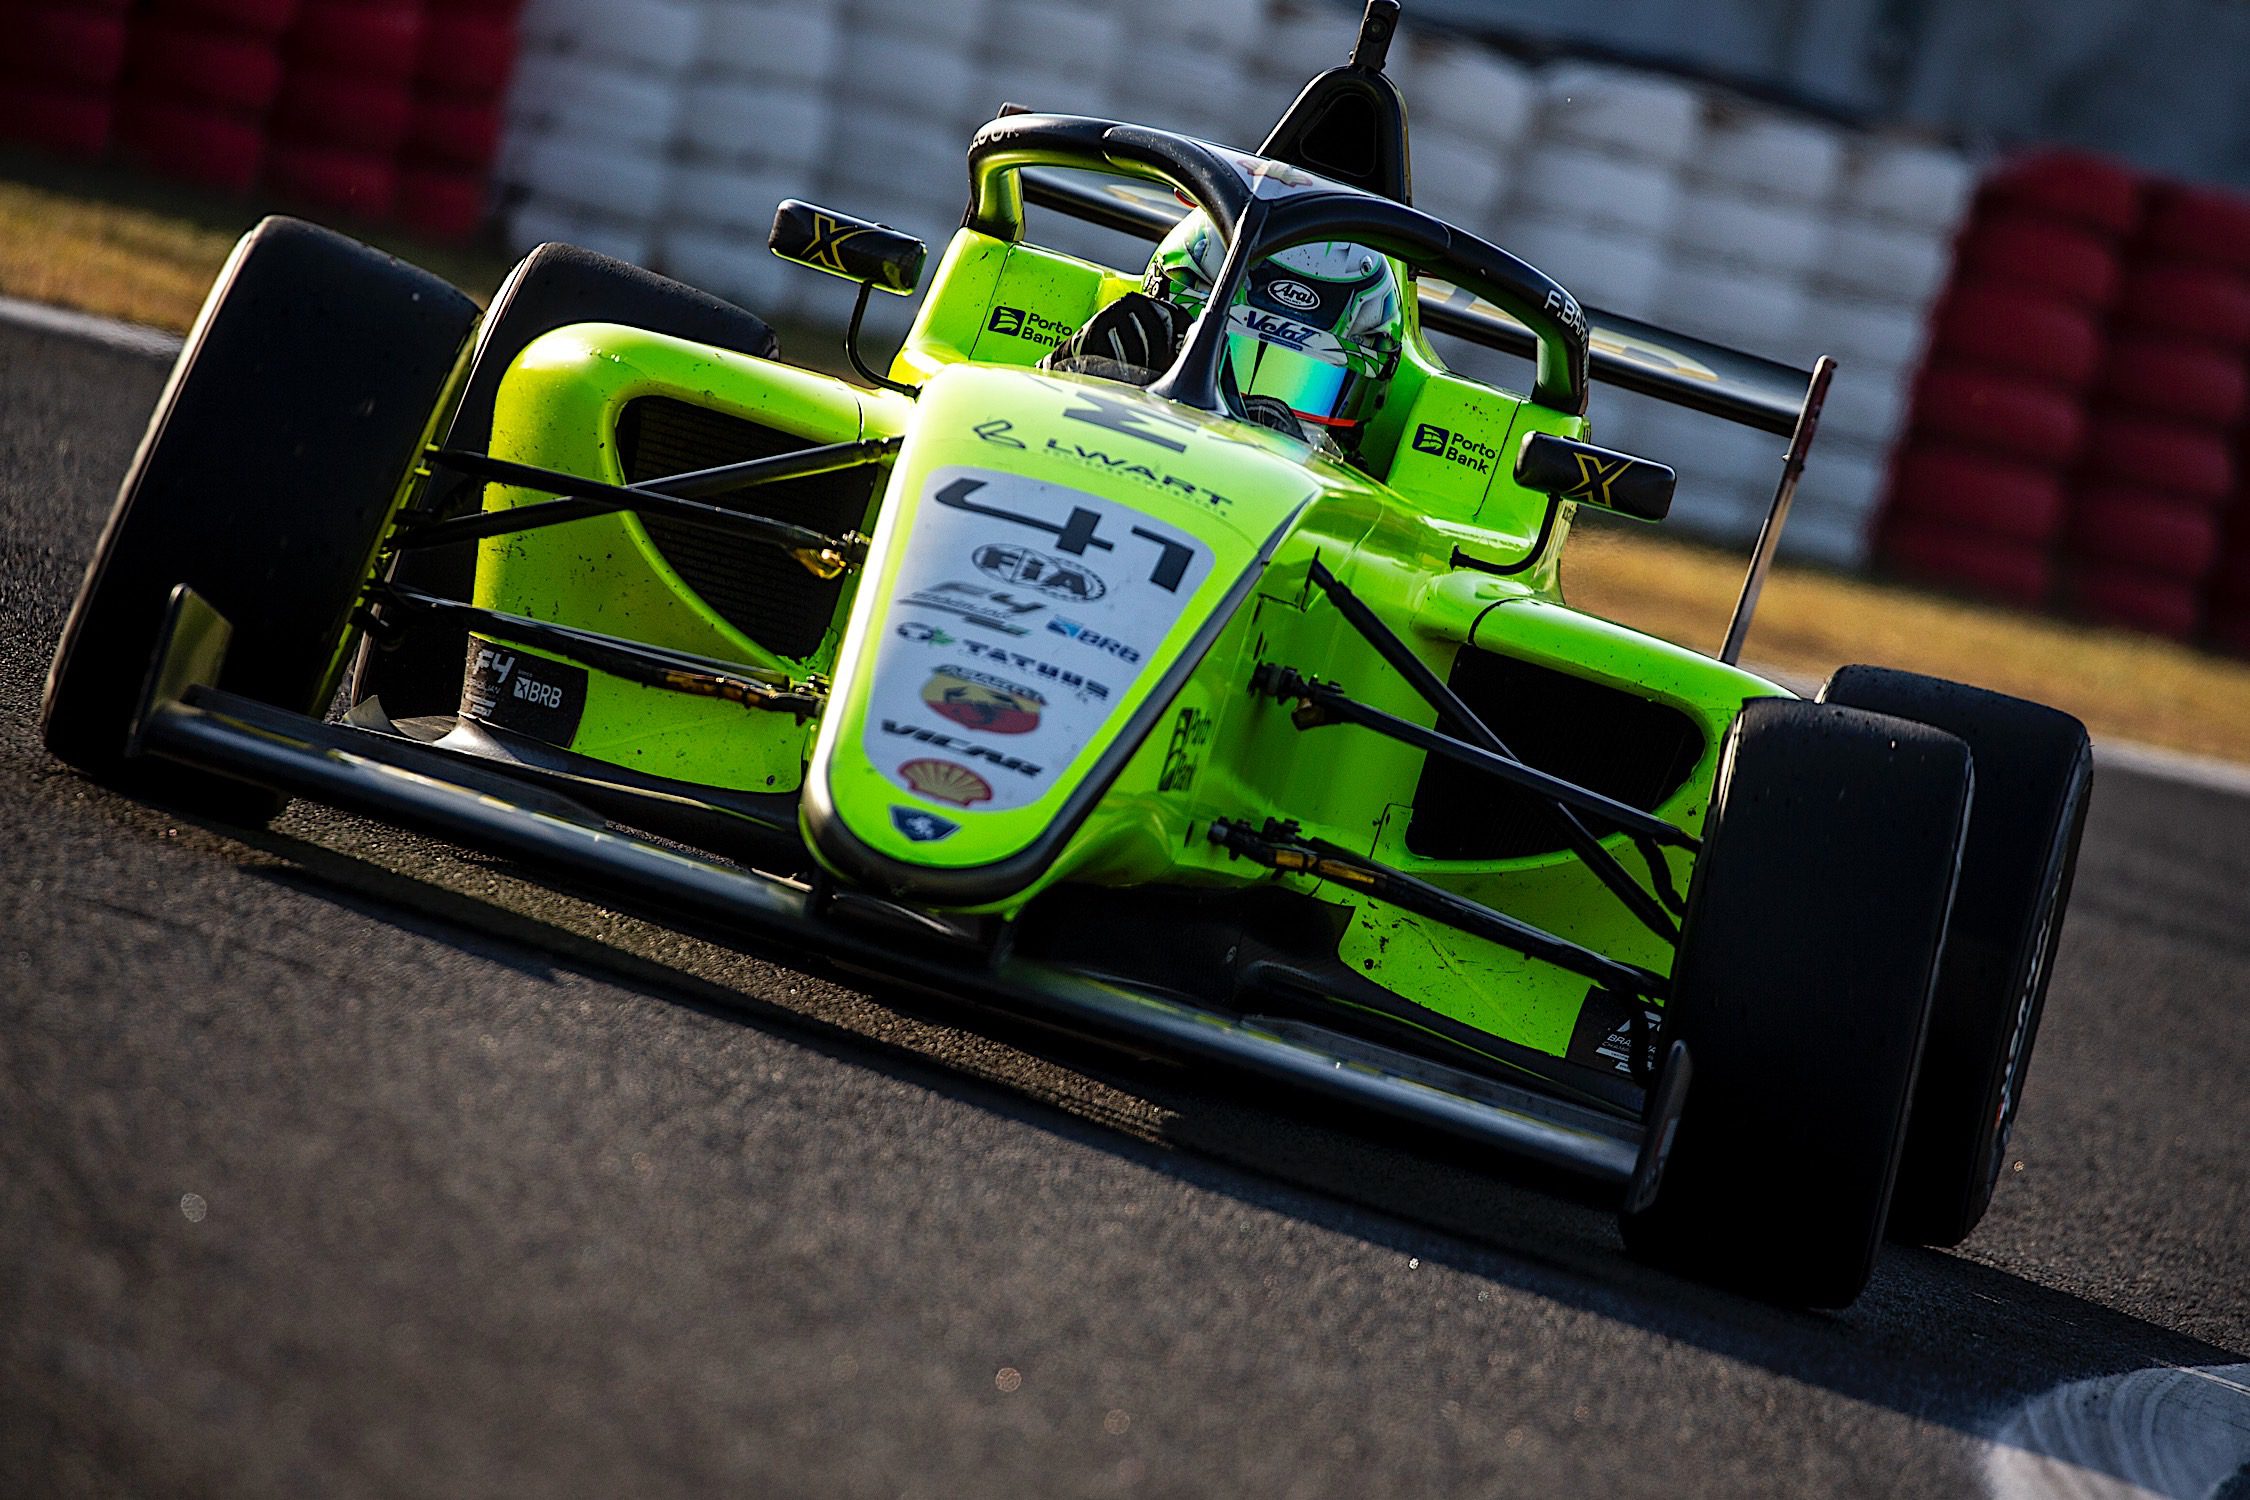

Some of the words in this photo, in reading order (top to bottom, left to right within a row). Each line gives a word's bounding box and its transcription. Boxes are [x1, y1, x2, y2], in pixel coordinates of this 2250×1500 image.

[1021, 326, 1062, 348] Bank
[1027, 312, 1073, 337] Porto
[1451, 432, 1496, 459] Porto
[1046, 438, 1233, 506] LWART
[1445, 446, 1489, 475] Bank
[935, 478, 1194, 592] 41
[980, 546, 1088, 597] FIA
[473, 648, 516, 684] F4
[528, 681, 563, 709] BRB
